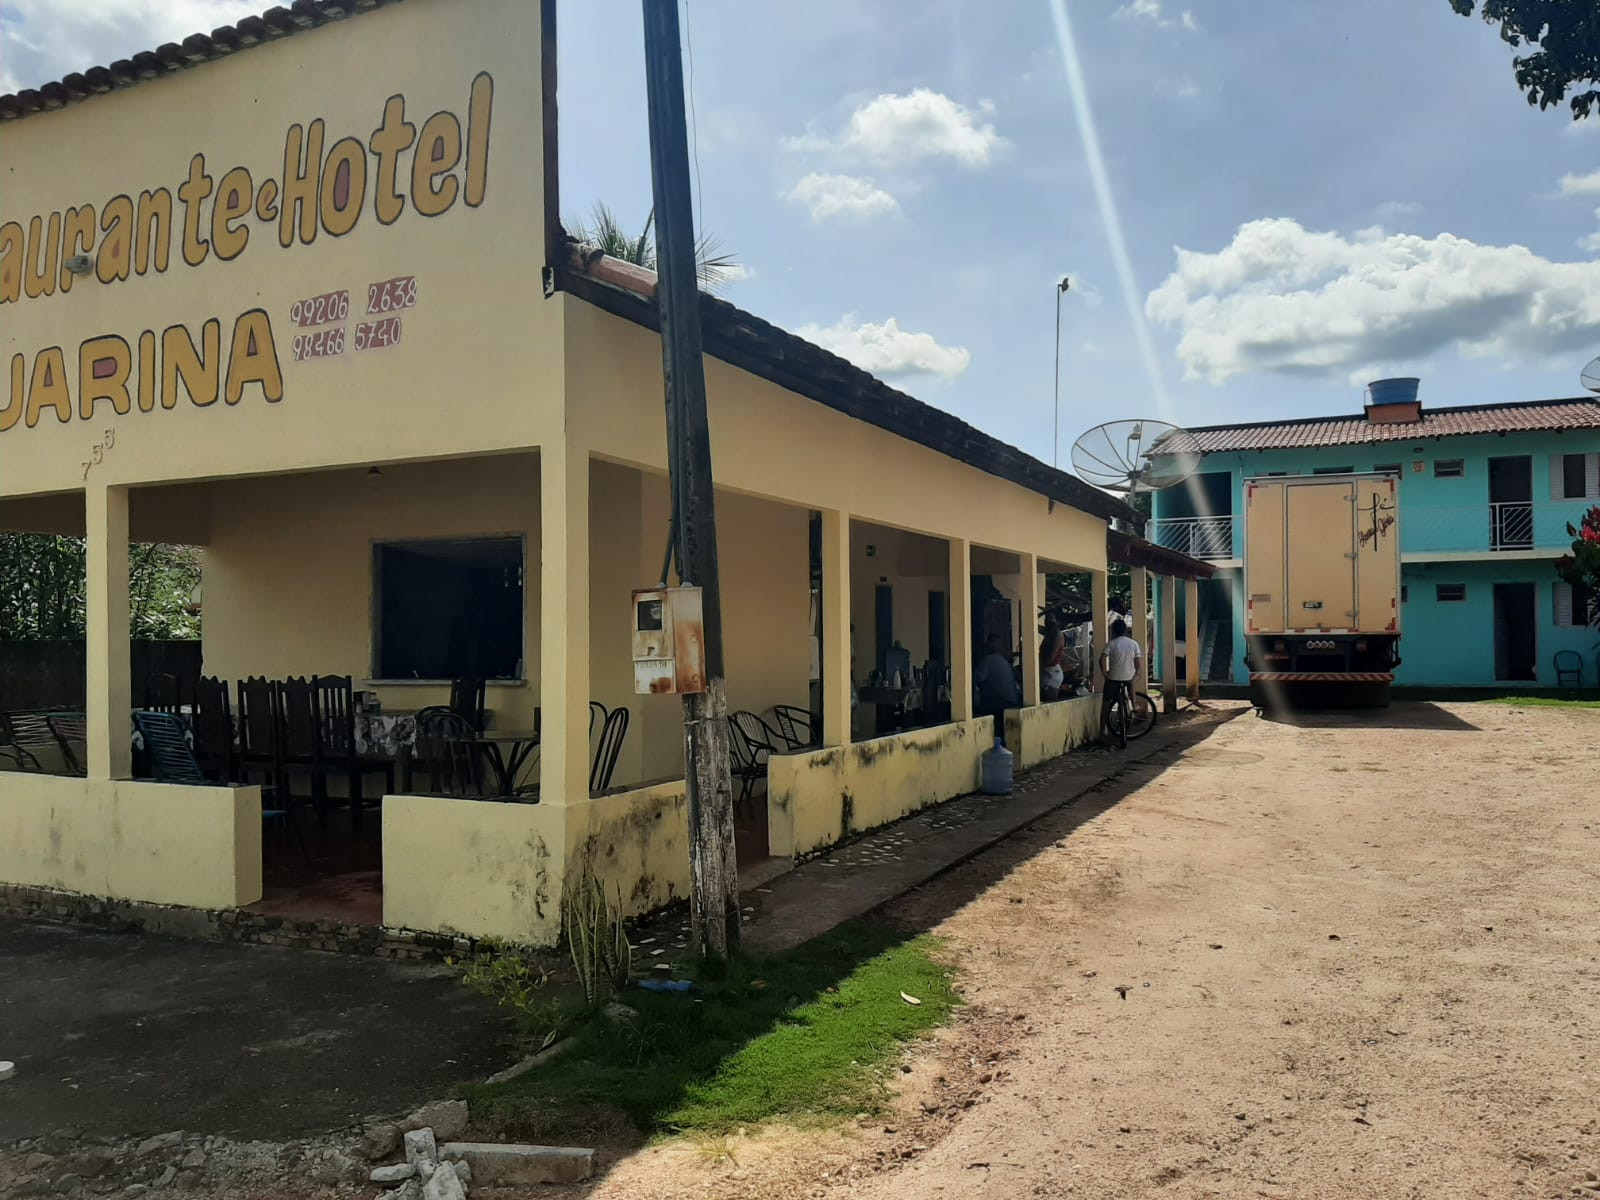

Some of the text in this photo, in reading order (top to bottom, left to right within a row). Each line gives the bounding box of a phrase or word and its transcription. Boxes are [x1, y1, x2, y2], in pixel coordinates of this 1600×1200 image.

[257, 178, 279, 221] e
[279, 71, 494, 248] Hotel
[291, 278, 417, 326] 99206 2638
[292, 318, 402, 361] 98466 5740
